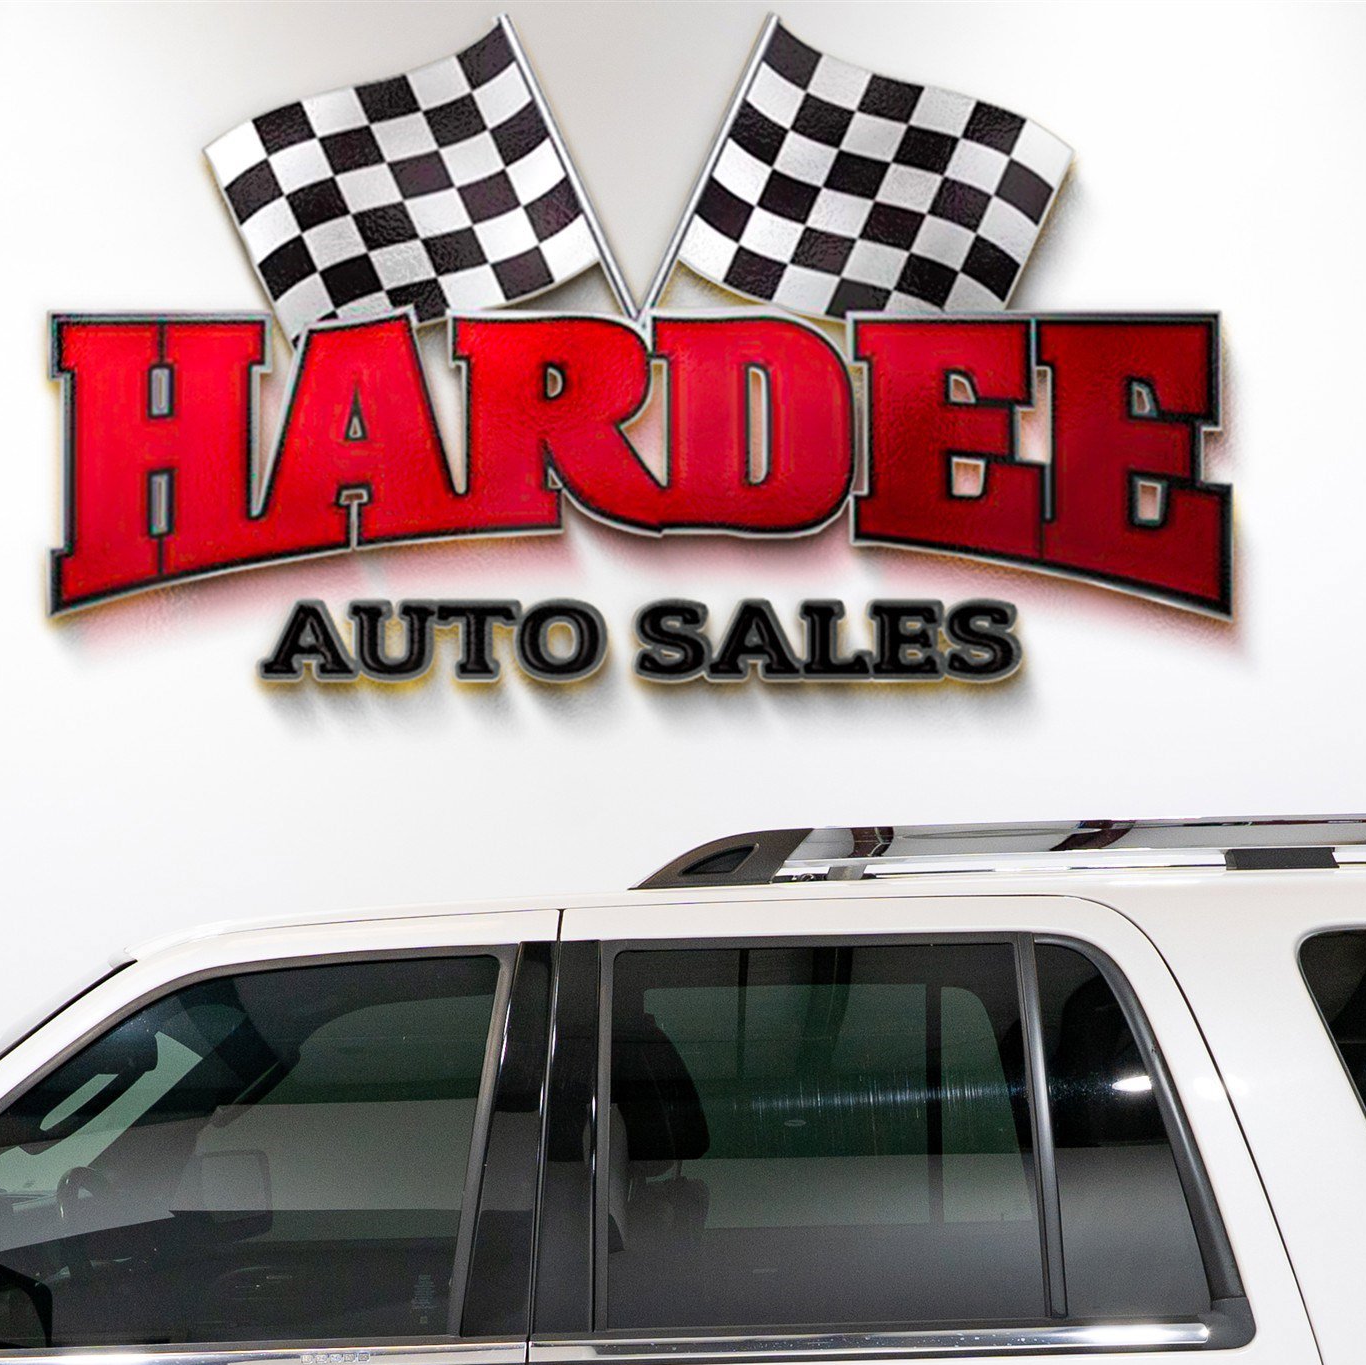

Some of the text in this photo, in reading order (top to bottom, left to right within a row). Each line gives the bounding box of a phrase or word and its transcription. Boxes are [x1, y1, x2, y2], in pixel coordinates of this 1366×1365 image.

[48, 309, 1234, 621] HARDEE
[260, 598, 1023, 682] AUTO SALES
